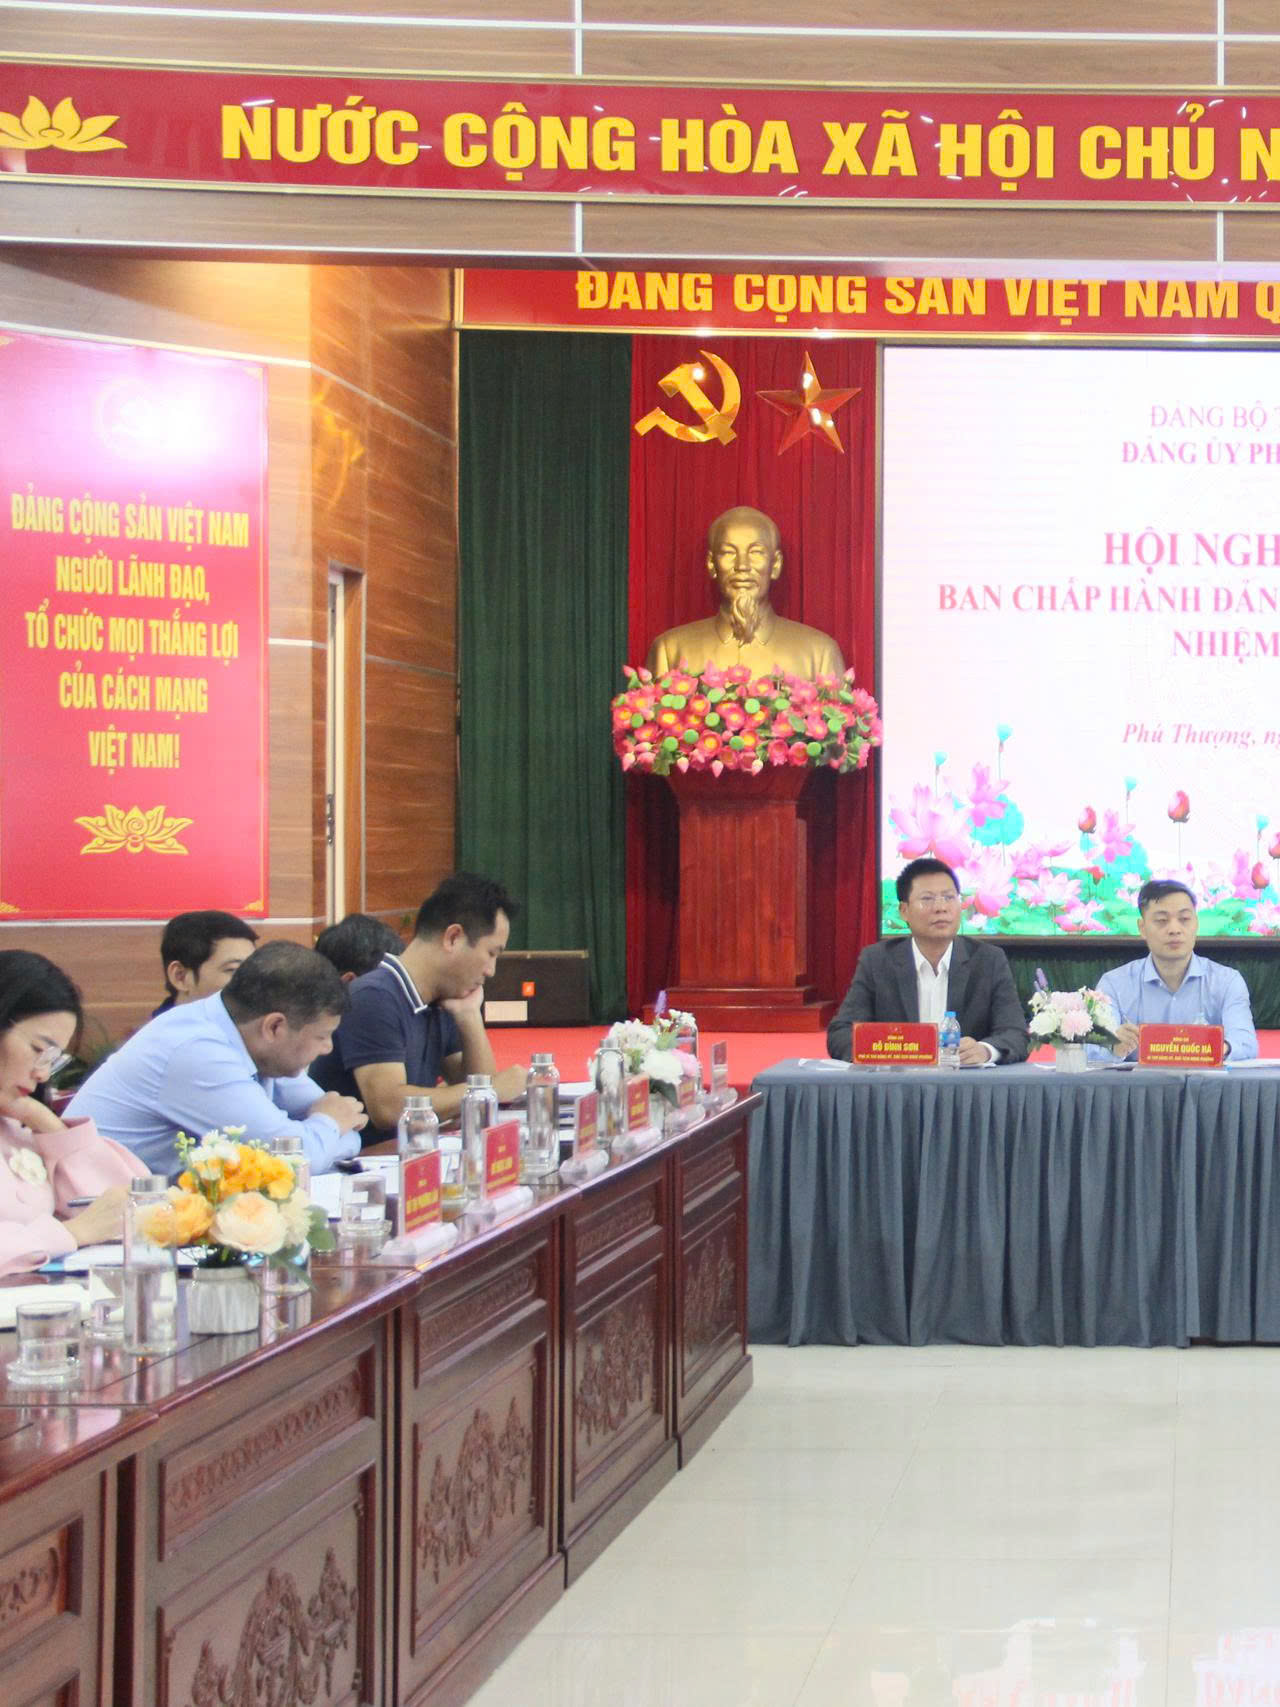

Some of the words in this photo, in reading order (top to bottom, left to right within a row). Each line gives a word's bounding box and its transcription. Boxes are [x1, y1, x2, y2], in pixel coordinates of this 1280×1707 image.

[221, 96, 419, 165] NƯỚC
[444, 102, 635, 181] CỘNG
[661, 104, 799, 173] HÒA
[822, 109, 917, 176] XÃ
[939, 109, 1054, 191] HỘI
[1080, 103, 1214, 180] CHỦ
[1125, 280, 1238, 318] NAM
[1233, 400, 1267, 432] BỘ
[11, 482, 64, 532] ĐẢNG
[70, 493, 120, 543] CỘNG
[126, 493, 162, 540] SẢN
[167, 501, 202, 551] VIỆT
[209, 512, 248, 547] NAM
[1104, 525, 1179, 575] HỘI
[56, 549, 113, 592] NGƯỜI
[119, 555, 165, 598] LÃNH
[170, 564, 209, 608] ĐẠO,
[938, 584, 1002, 612] BAN
[1109, 578, 1200, 613] HÀNH
[25, 598, 50, 648] TỔ
[55, 608, 104, 652] CHỨC
[110, 618, 144, 661] MỌI
[150, 608, 207, 657] THẮNG
[212, 622, 238, 666] LỢI
[1172, 627, 1280, 664] NHIỆM
[60, 660, 97, 709] CỦA
[102, 666, 150, 710] CÁCH
[156, 678, 208, 720] MẠNG
[89, 724, 127, 775] VIỆT
[132, 732, 180, 768] NAM!
[1123, 723, 1163, 744] Phú
[1172, 723, 1257, 748] Thượng,
